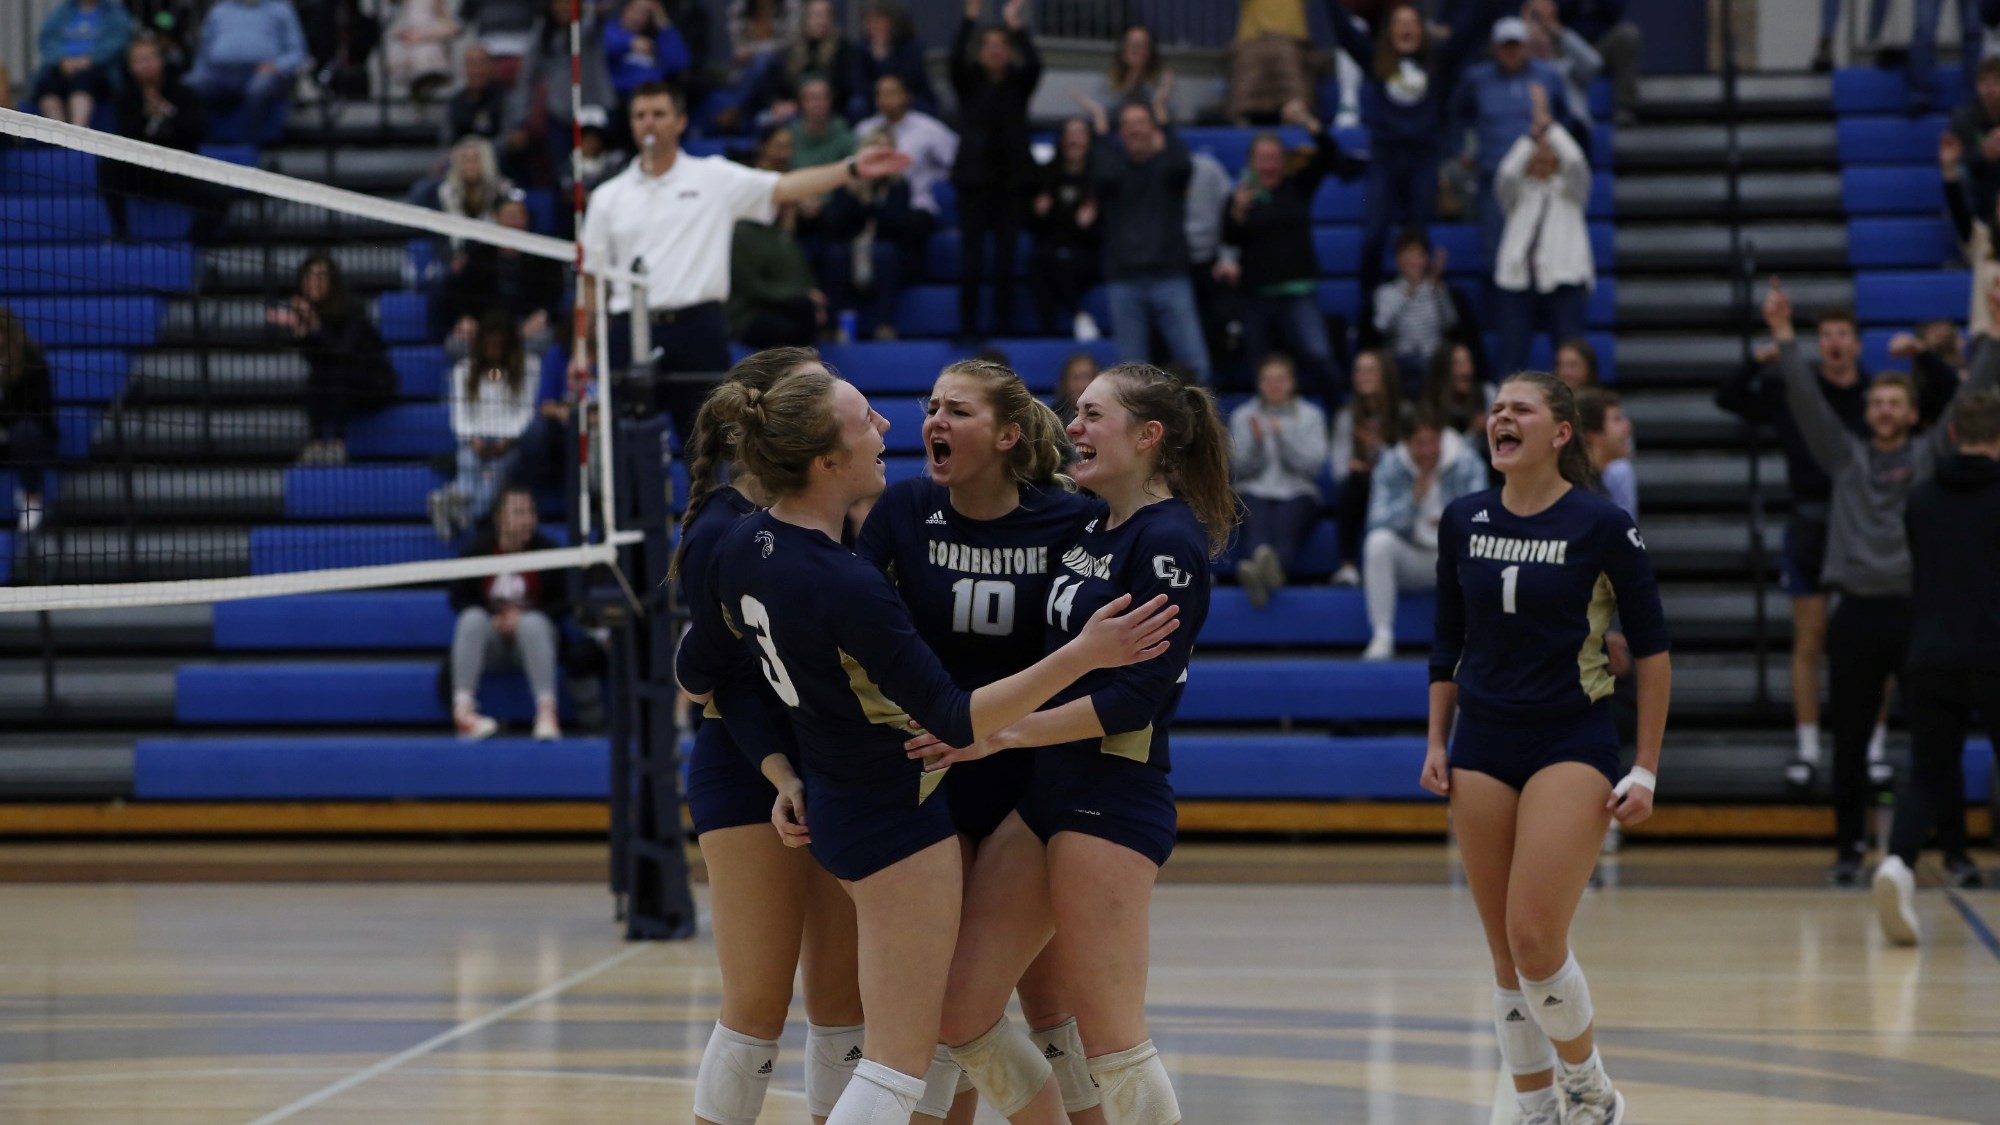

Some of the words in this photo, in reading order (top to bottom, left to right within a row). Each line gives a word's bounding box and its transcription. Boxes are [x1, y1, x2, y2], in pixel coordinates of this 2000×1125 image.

[928, 539, 1048, 575] CORNERSTONE
[1152, 554, 1193, 588] CU
[1469, 534, 1568, 565] CORNERSTONE
[951, 577, 1016, 636] 10
[1047, 574, 1085, 632] 14
[1501, 565, 1520, 614] 1
[740, 593, 800, 708] 3
